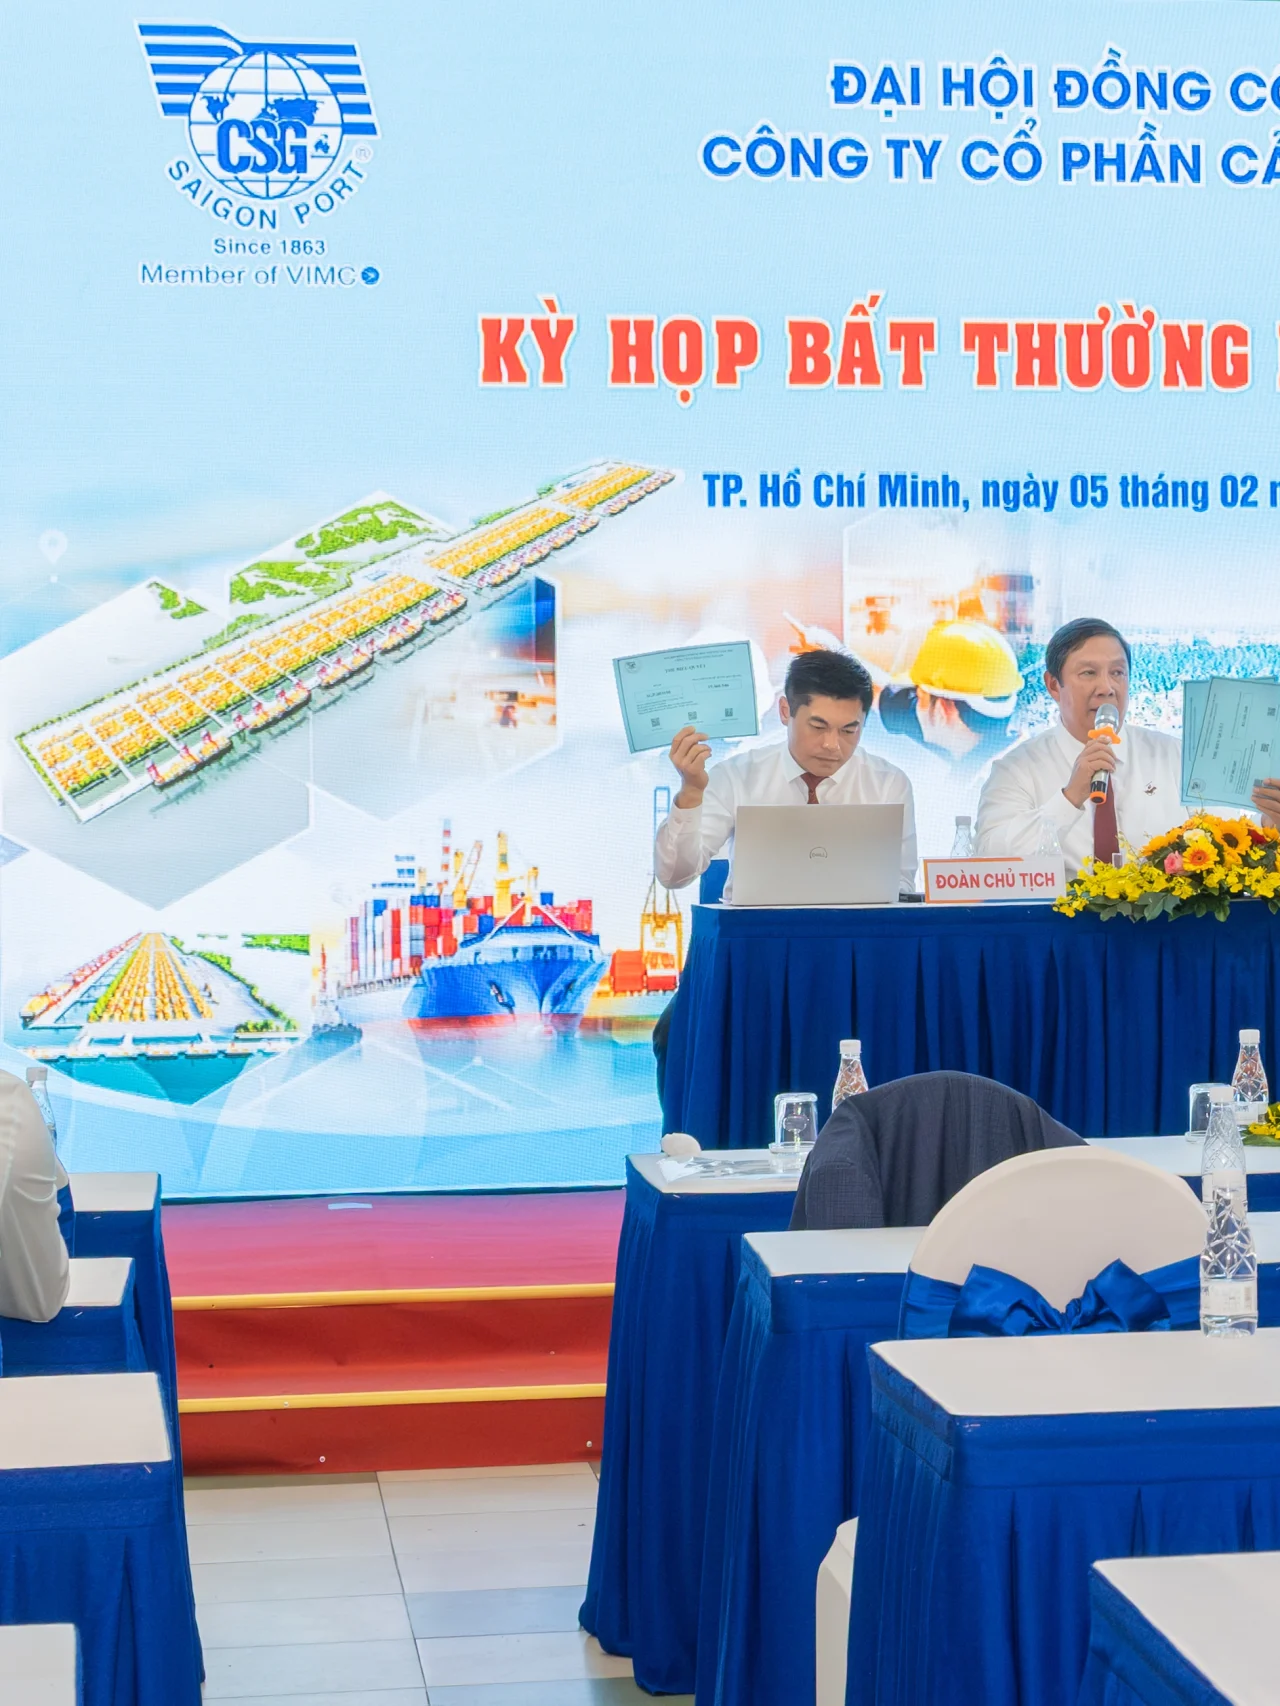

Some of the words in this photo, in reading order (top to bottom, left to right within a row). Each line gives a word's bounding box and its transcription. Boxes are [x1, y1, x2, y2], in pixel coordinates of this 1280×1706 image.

[831, 65, 921, 117] ĐẠI
[943, 56, 1034, 119] HỘI
[1054, 48, 1211, 113] ĐỒNG
[217, 119, 307, 174] CSG
[703, 124, 868, 178] CÔNG
[886, 140, 942, 179] TY
[962, 118, 1043, 181] CỔ
[1063, 122, 1201, 183] PHẦN
[168, 160, 276, 229] SAIGON
[294, 160, 364, 224] PORT
[214, 238, 271, 254] Since
[280, 239, 326, 255] 1863
[141, 264, 245, 284] Member
[255, 265, 279, 284] of
[286, 265, 356, 285] VIMC
[481, 297, 574, 384] KỲ
[610, 319, 758, 404] HỌP
[788, 294, 935, 386] BẤT
[963, 304, 1249, 389] THƯỜNG
[703, 473, 746, 507] TP.
[759, 467, 801, 508] Hồ
[813, 472, 865, 508] Chí
[879, 472, 970, 513] Minh,
[981, 472, 1058, 513] ngày
[1070, 474, 1108, 509] 05
[1119, 473, 1209, 512] tháng
[1220, 474, 1258, 508] 02
[935, 869, 980, 889] ĐOÀN
[984, 867, 1016, 888] CHỦ
[1019, 872, 1055, 892] TỊCH
